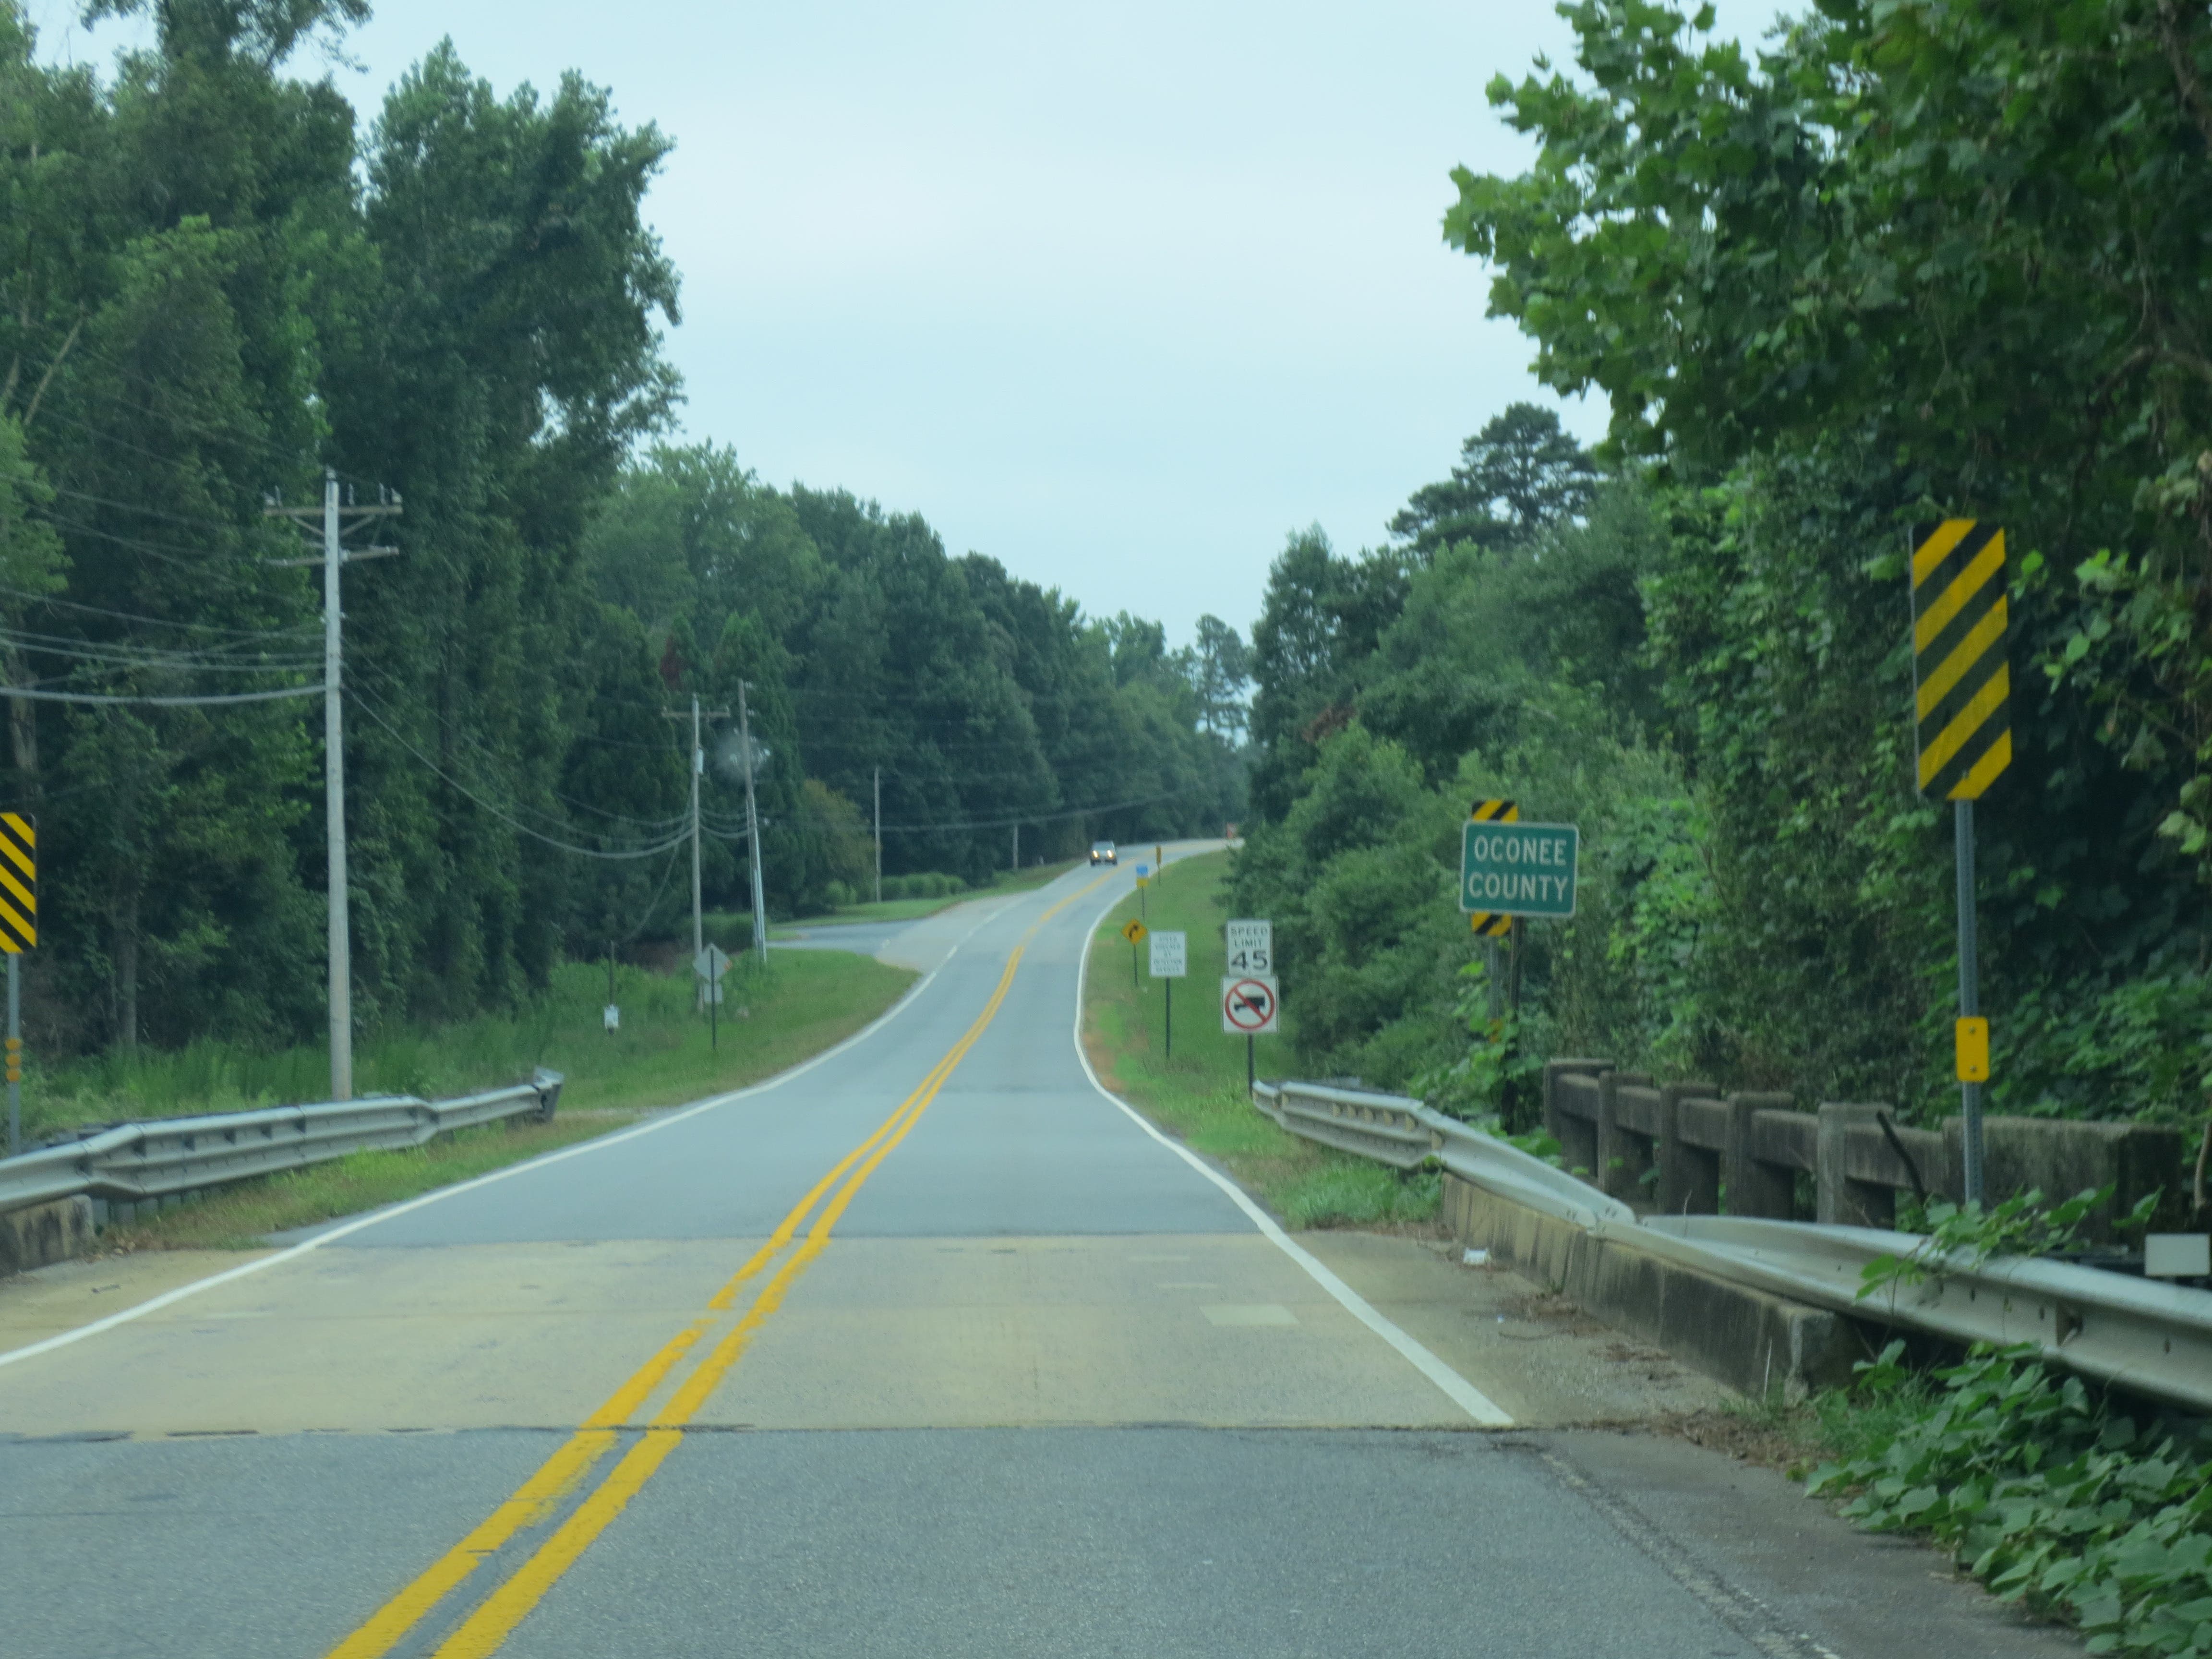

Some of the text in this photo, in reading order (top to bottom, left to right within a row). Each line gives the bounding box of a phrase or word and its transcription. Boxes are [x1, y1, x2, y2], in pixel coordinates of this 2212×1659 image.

[1474, 835, 1567, 866] OCONEE
[1468, 872, 1569, 902] COUNTY
[1230, 926, 1268, 937] SPEED
[1234, 938, 1262, 949] LIMIT
[1230, 950, 1268, 970] 45
